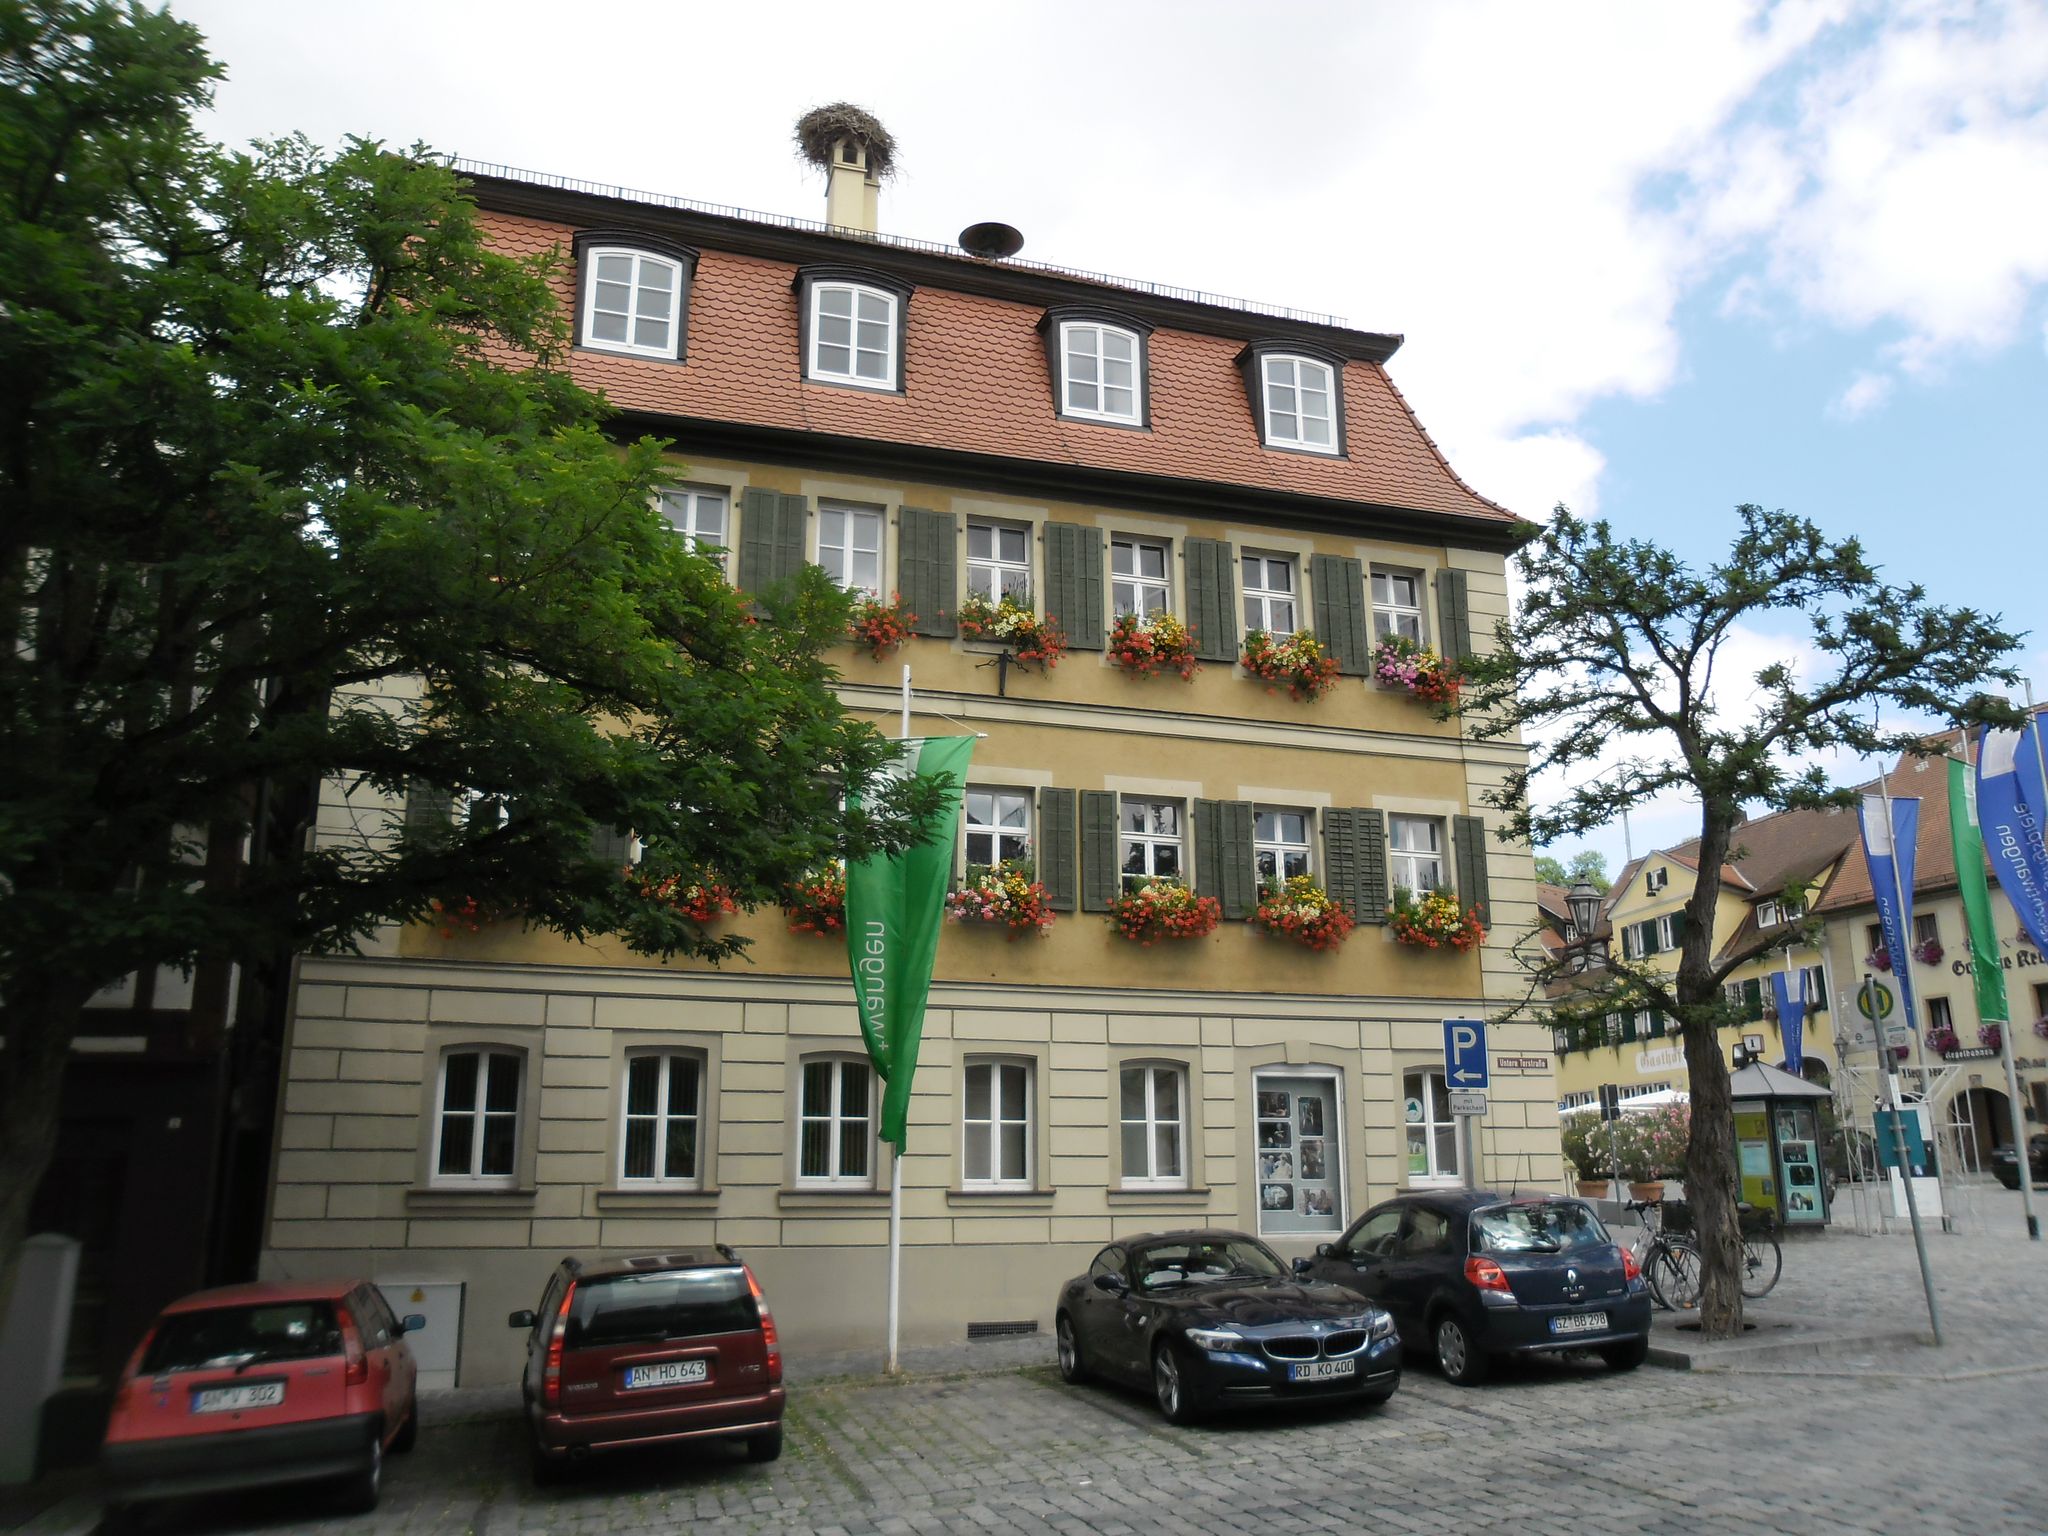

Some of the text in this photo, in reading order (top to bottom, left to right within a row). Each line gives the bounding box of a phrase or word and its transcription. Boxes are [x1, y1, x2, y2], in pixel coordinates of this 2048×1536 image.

[1452, 1026, 1477, 1065] P
[1555, 1312, 1606, 1329] GZ BB 298
[632, 1362, 705, 1383] AN HO 643
[1295, 1364, 1311, 1377] RD
[1334, 1360, 1354, 1374] 400
[249, 1386, 277, 1401] 302
